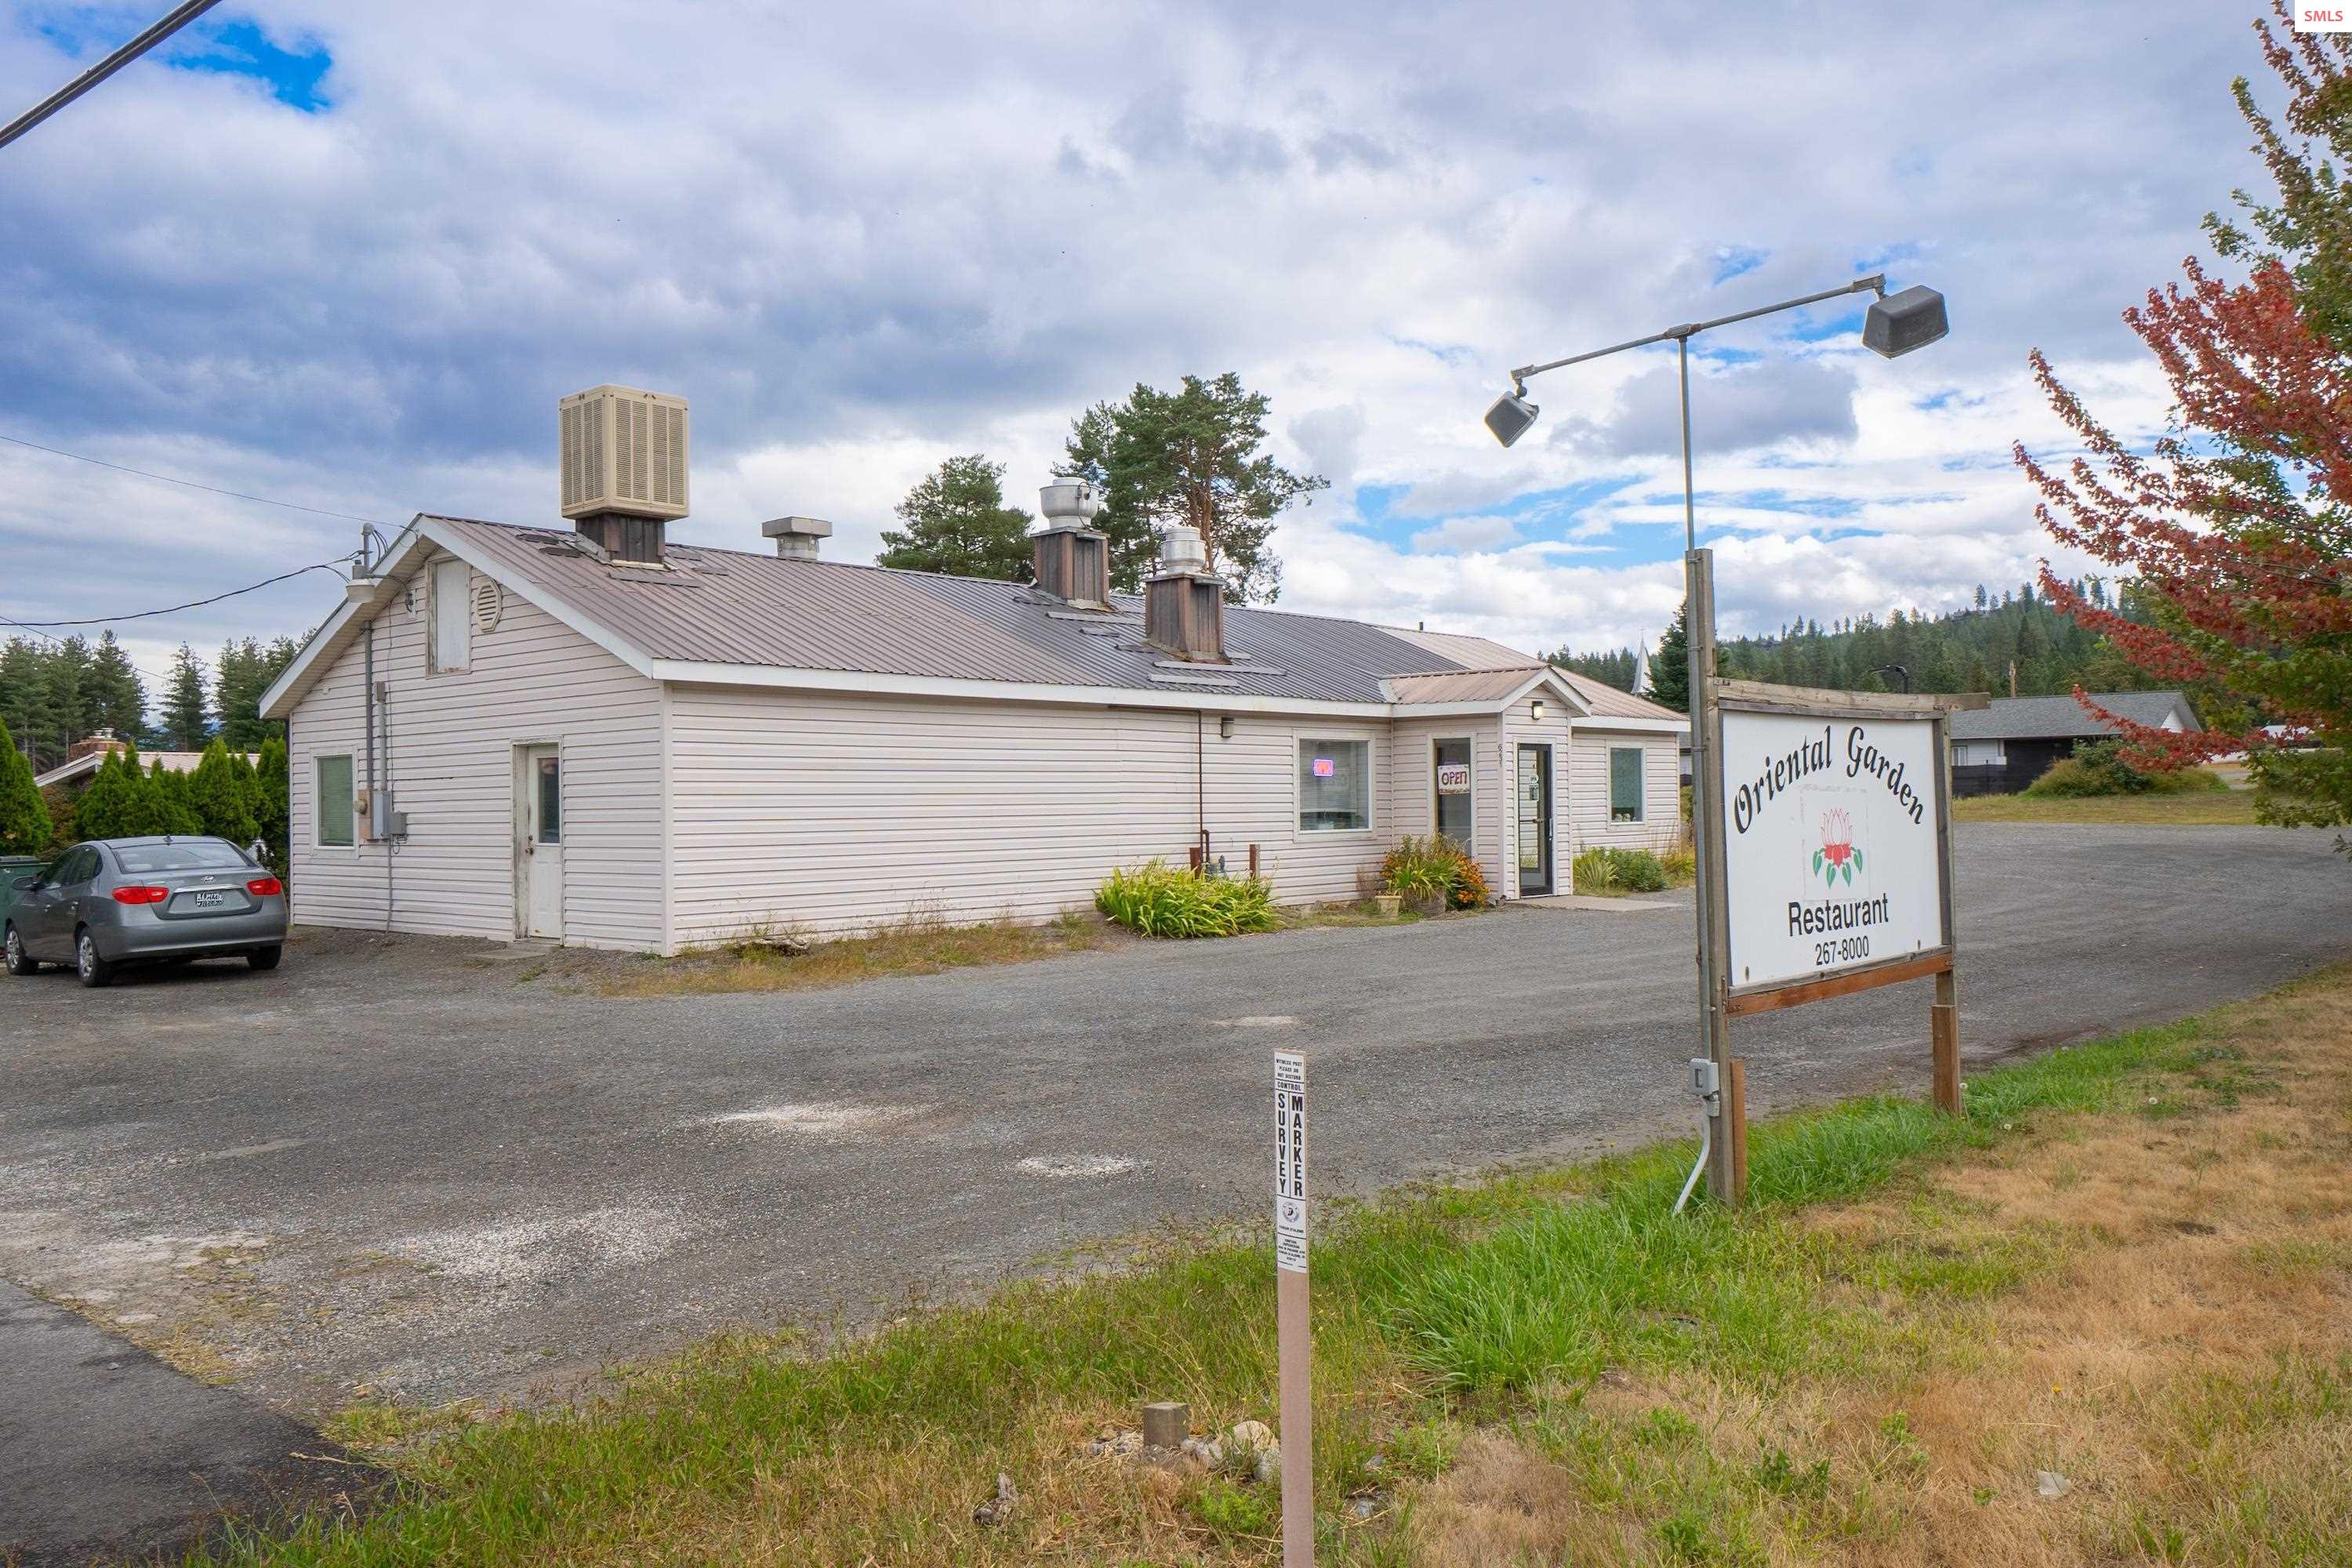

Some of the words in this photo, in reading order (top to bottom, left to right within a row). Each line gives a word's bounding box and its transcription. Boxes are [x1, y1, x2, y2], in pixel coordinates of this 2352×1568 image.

[1733, 725, 1832, 834] Oriental
[1846, 726, 1924, 825] Garden
[1788, 892, 1889, 937] Restaurant
[1815, 935, 1869, 966] 267-8000
[1277, 1082, 1301, 1091] CONTROL
[1291, 1095, 1303, 1197] MARKER
